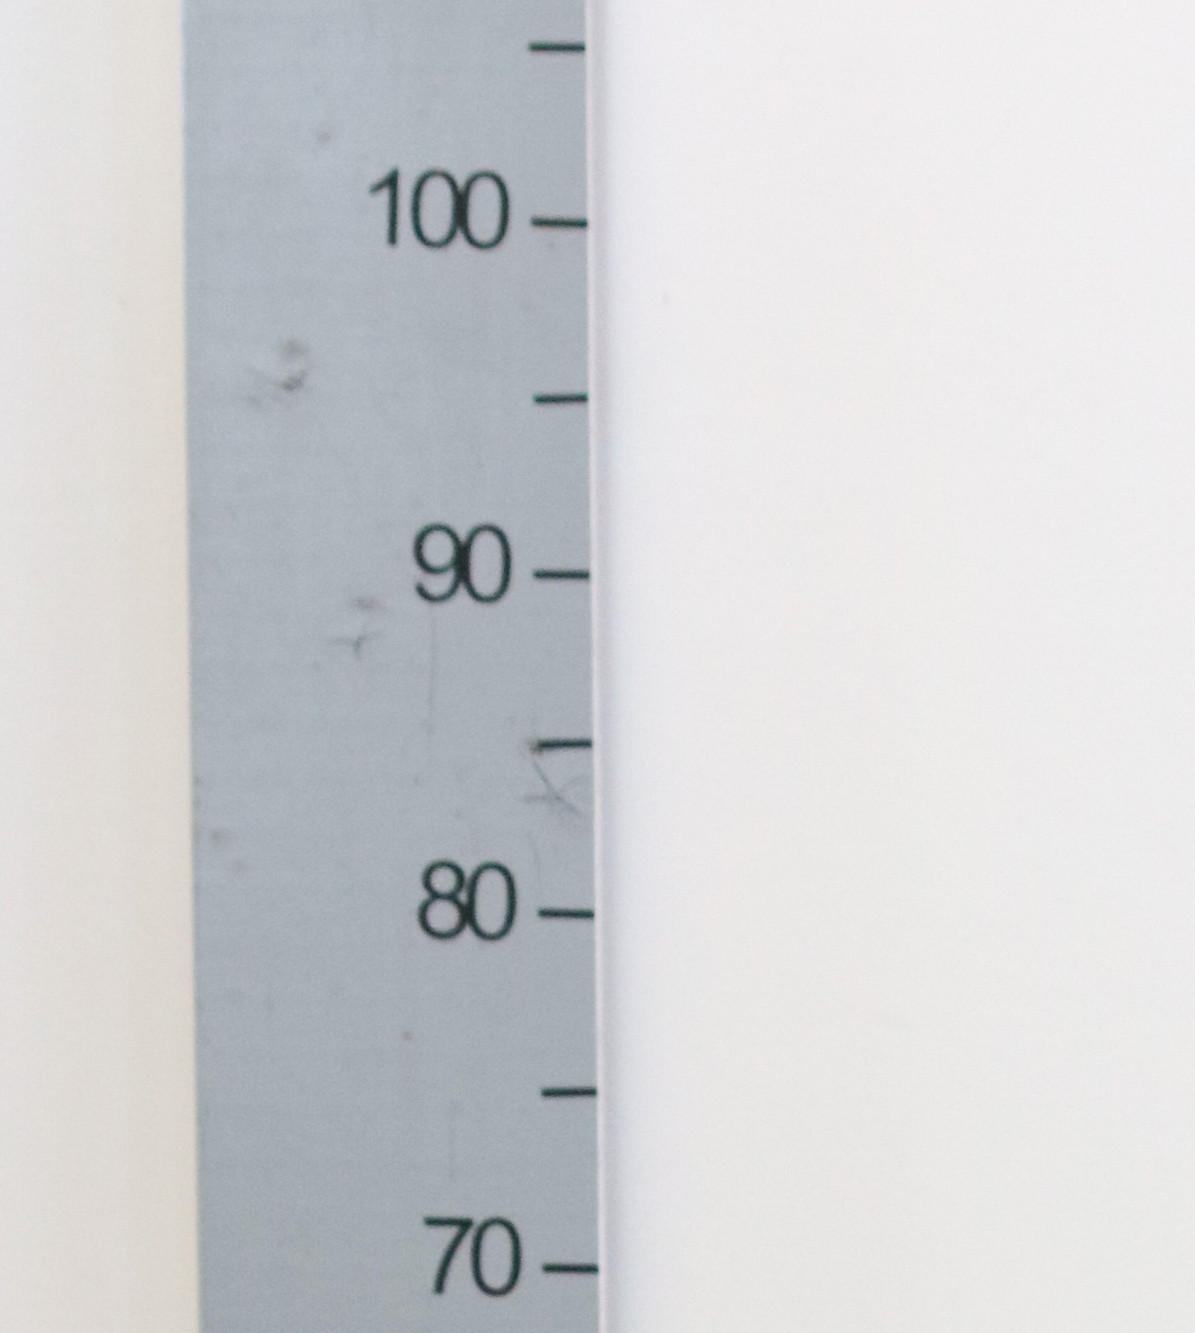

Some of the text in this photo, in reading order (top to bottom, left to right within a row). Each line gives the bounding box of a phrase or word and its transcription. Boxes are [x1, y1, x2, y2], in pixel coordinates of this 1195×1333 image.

[369, 168, 510, 250] 100
[413, 524, 512, 602] 90
[417, 861, 517, 940] 80
[423, 1217, 523, 1297] 70
